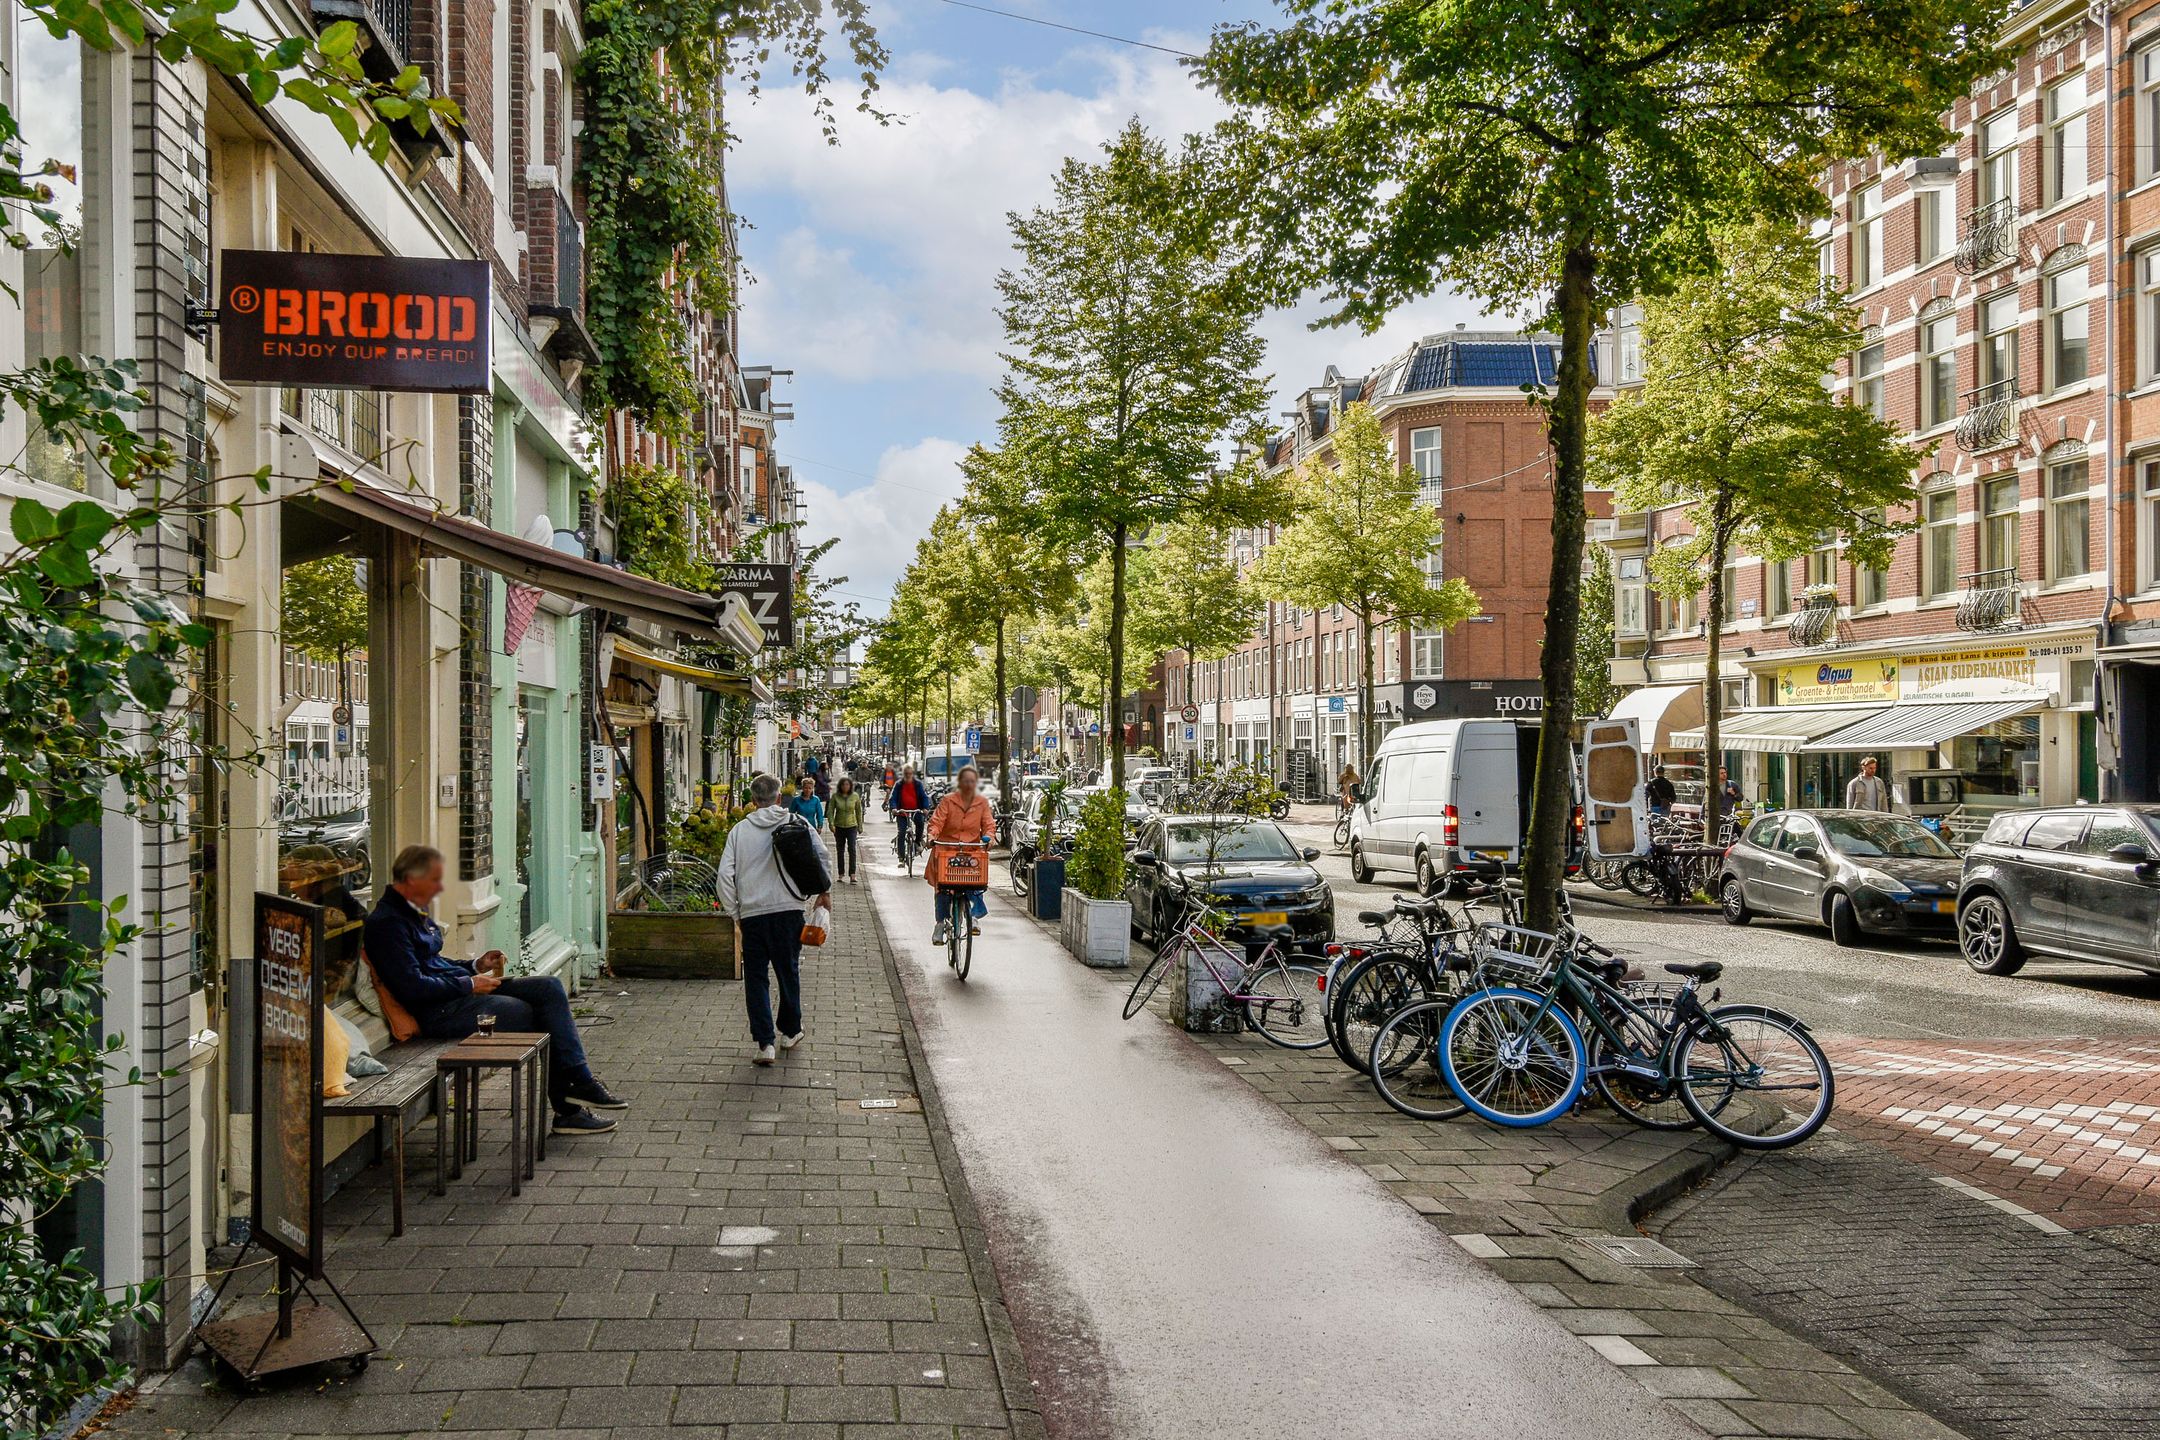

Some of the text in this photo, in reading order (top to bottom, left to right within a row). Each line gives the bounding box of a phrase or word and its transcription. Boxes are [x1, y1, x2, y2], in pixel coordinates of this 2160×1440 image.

[197, 310, 217, 318] stoop
[264, 288, 476, 342] BROOD
[263, 342, 474, 363] ENJOY OUR BREAD!
[715, 568, 774, 581] OARMA
[1992, 649, 2025, 659] kipvlees
[1817, 664, 1852, 685] Olgun
[1917, 659, 2037, 693] ASIAN SUPERMARKET
[1796, 681, 1876, 697] Groente- & Fruithandel
[1495, 696, 1544, 711] HOT
[269, 926, 301, 960] VERS
[261, 958, 312, 1005] DESEM
[265, 1003, 306, 1041] BROOD
